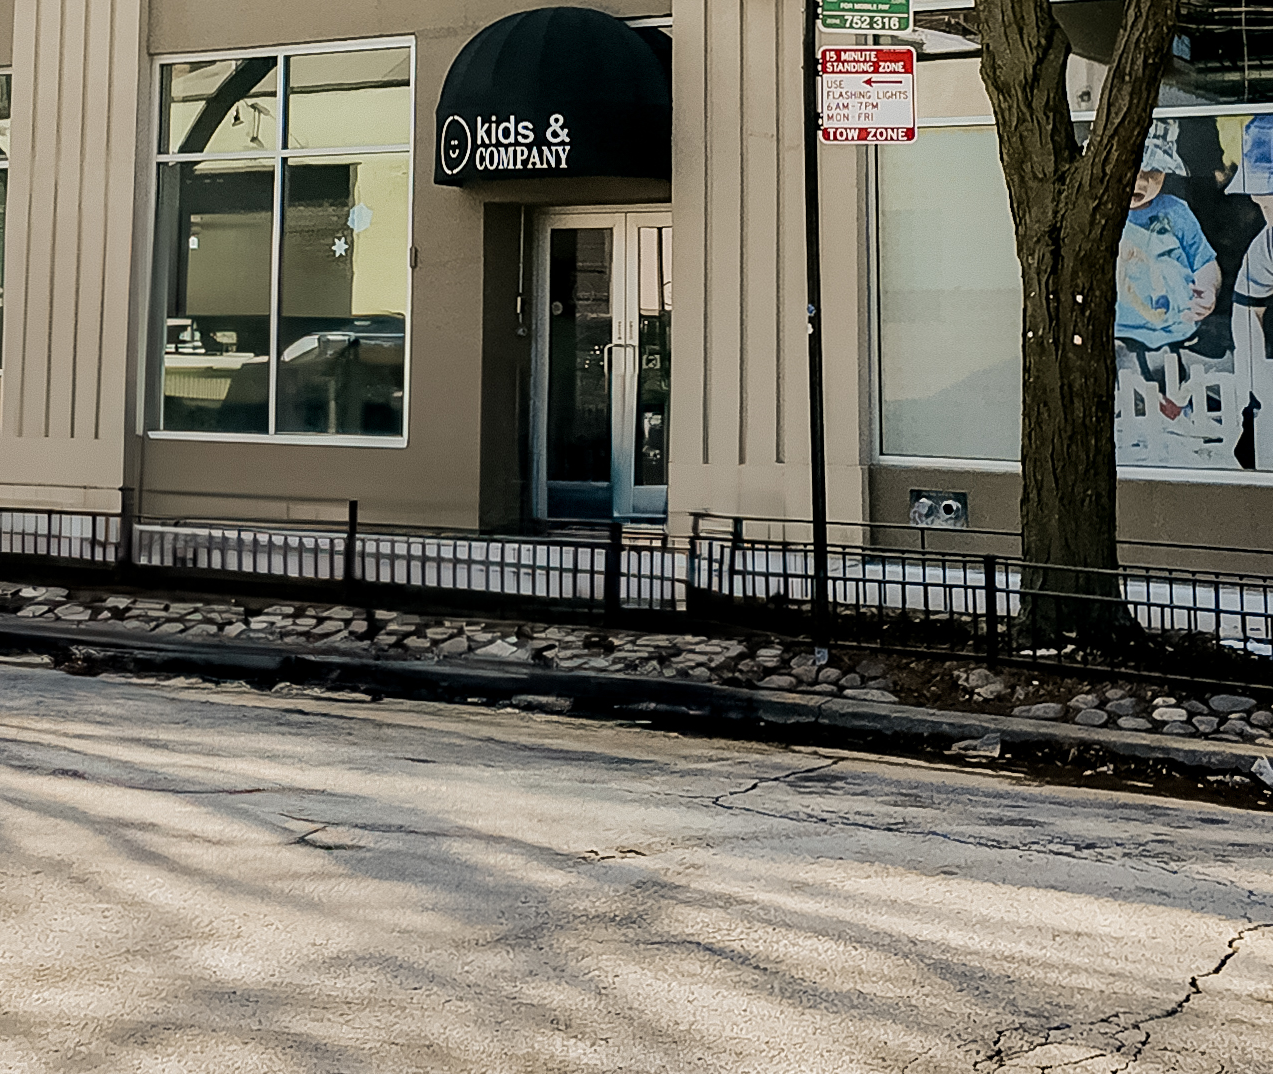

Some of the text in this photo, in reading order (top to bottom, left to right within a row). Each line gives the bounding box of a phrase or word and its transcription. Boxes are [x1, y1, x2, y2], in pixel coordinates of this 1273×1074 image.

[844, 15, 870, 29] 752
[872, 16, 899, 30] 316
[826, 51, 877, 62] 15 MINUTE
[826, 62, 905, 73] STANDING ZONE
[826, 79, 844, 89] USE
[826, 90, 908, 100] FLASHING LIGHTS
[476, 113, 571, 145] kids &
[827, 128, 908, 141] TOW ZONE
[475, 145, 571, 170] COMPANY
